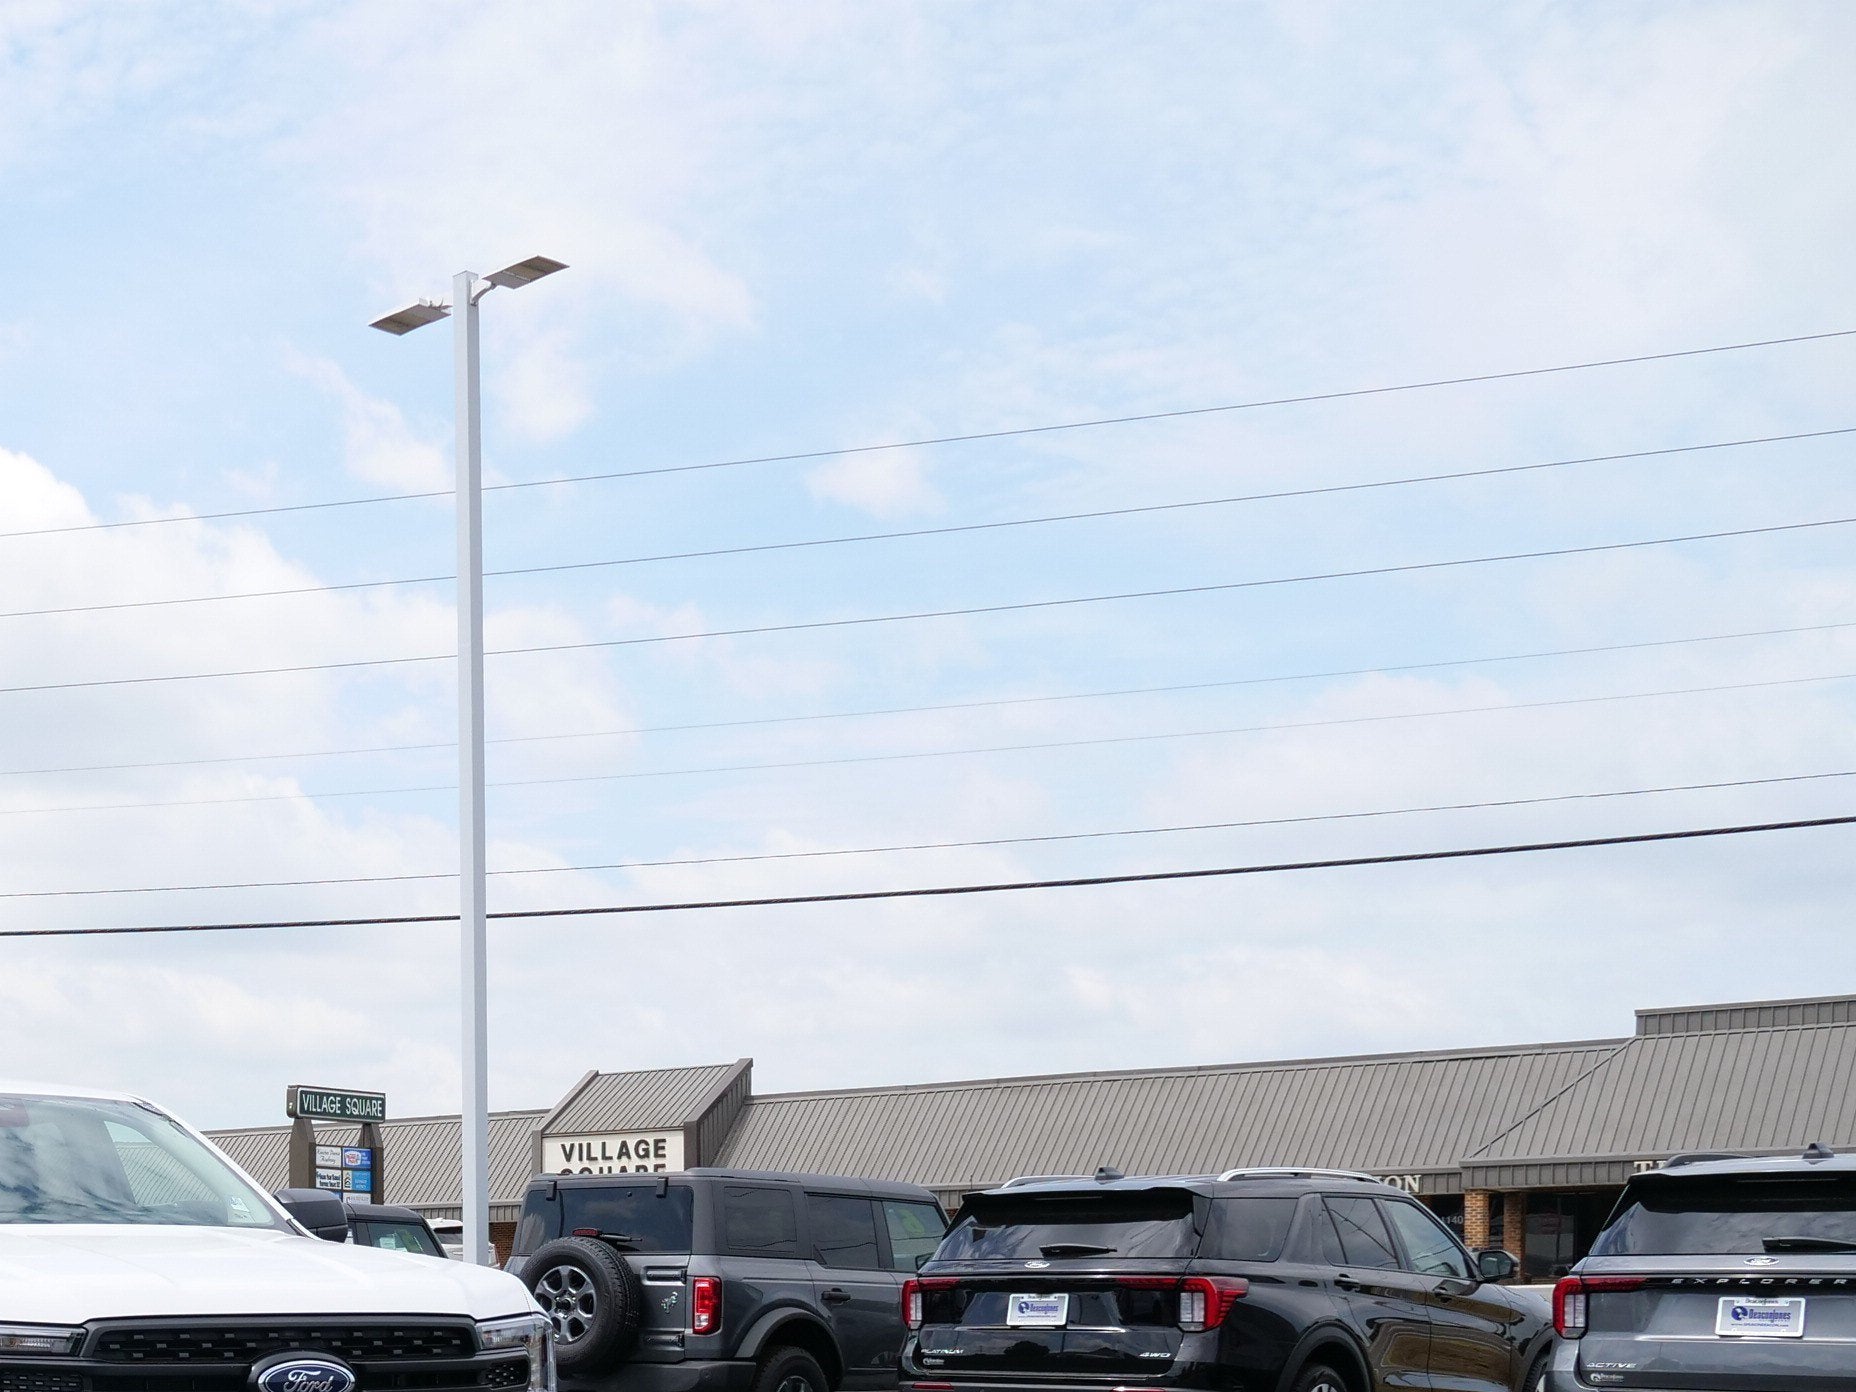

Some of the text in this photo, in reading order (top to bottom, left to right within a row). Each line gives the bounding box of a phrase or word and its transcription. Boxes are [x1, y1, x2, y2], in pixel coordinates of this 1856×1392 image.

[302, 1094, 382, 1117] VILLAGE SQUARE
[560, 1138, 667, 1162] VILLAGE
[1375, 1174, 1422, 1194] ON
